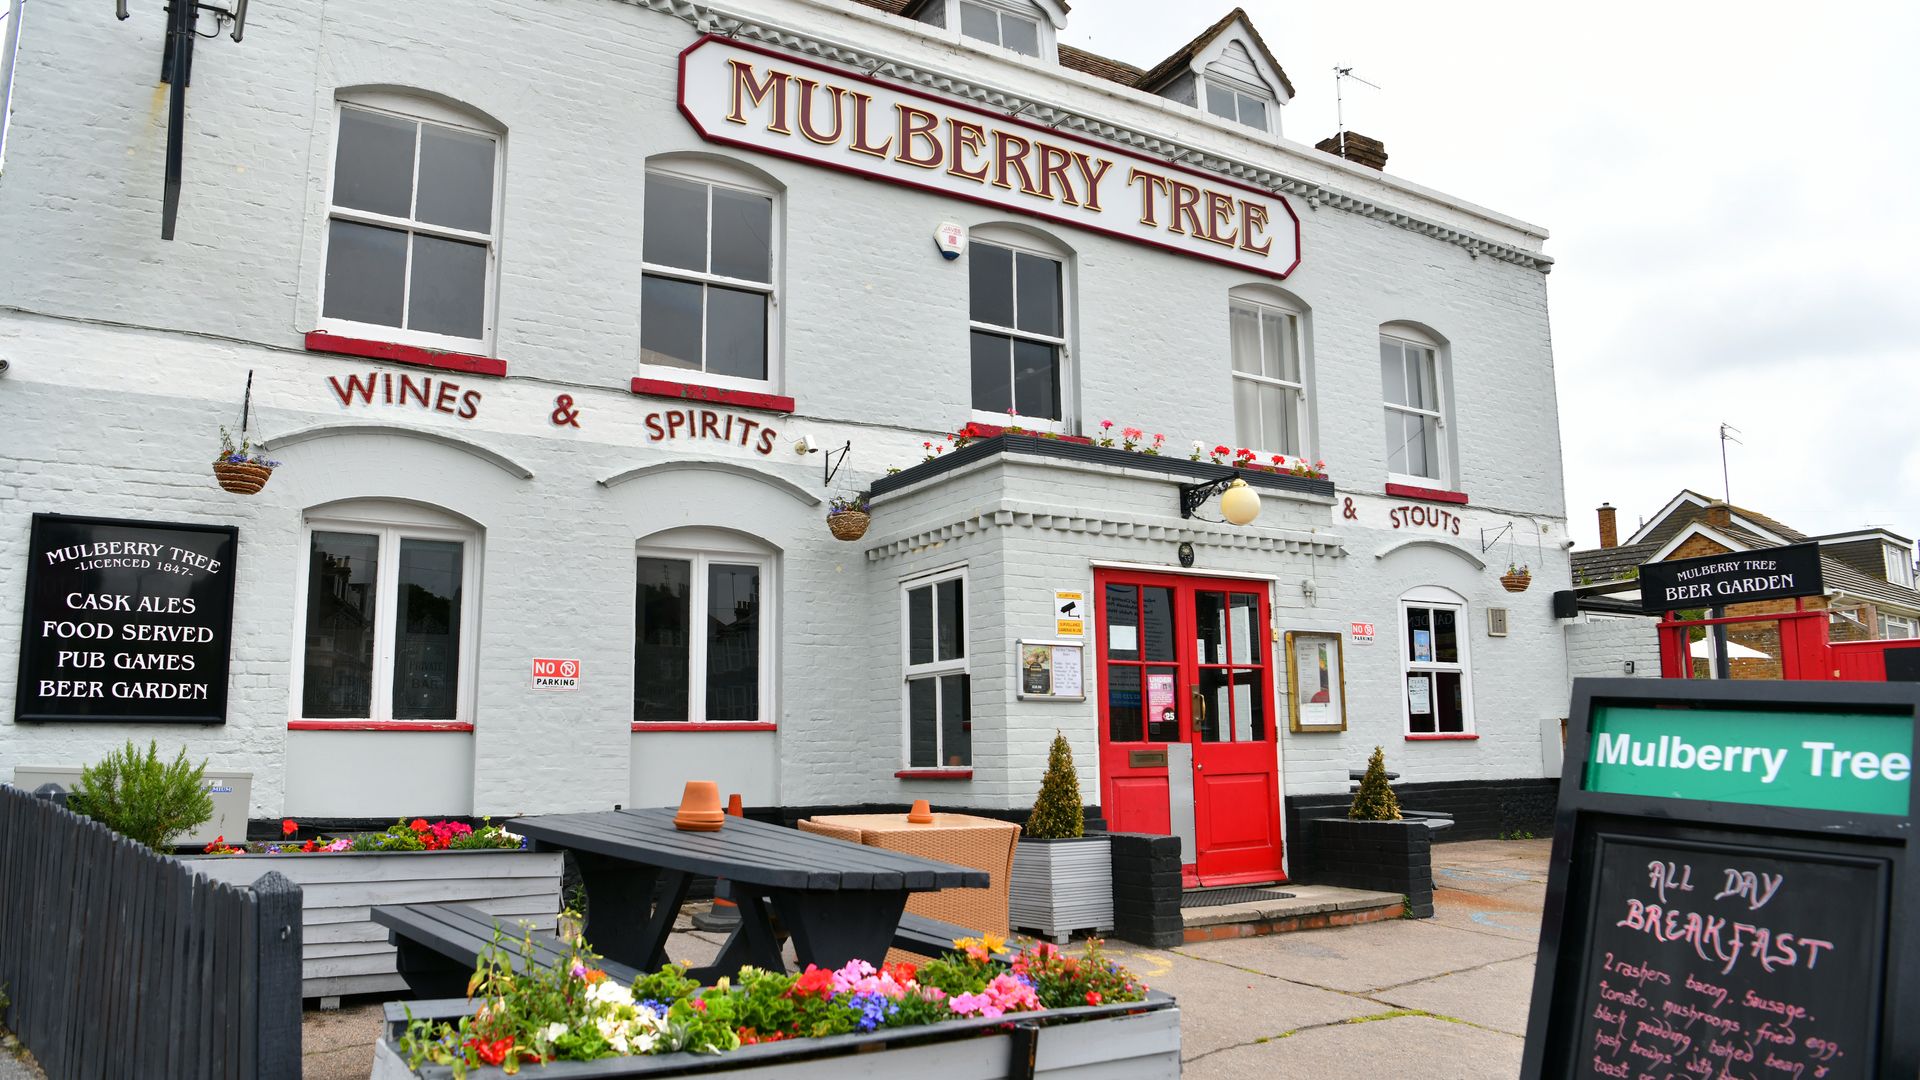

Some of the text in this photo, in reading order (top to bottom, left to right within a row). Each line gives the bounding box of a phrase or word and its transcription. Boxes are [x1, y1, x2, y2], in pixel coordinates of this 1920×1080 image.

[726, 57, 1274, 257] MULBERRY TREE
[325, 372, 778, 456] WINES & SPIRITS
[1343, 496, 1461, 536] & STOUTS
[46, 541, 222, 575] MULBERRY TREE
[1676, 560, 1777, 582] MULBERRY TREE
[1665, 573, 1795, 601] BEER GARDEN
[66, 592, 197, 614] CASK ALES
[42, 621, 214, 643] FOOD SERVED
[1352, 625, 1363, 634] NO
[57, 651, 196, 671] PUB GAMES
[535, 661, 556, 675] NO
[38, 680, 209, 700] BEER GARDEN
[536, 678, 575, 686] PARKING
[1596, 732, 1911, 783] Mulberry Tree
[1648, 860, 1783, 910] ALL DAY
[1616, 898, 1834, 976] BREAKFAST
[1603, 952, 1613, 971] 2
[1615, 961, 1671, 988] rashers
